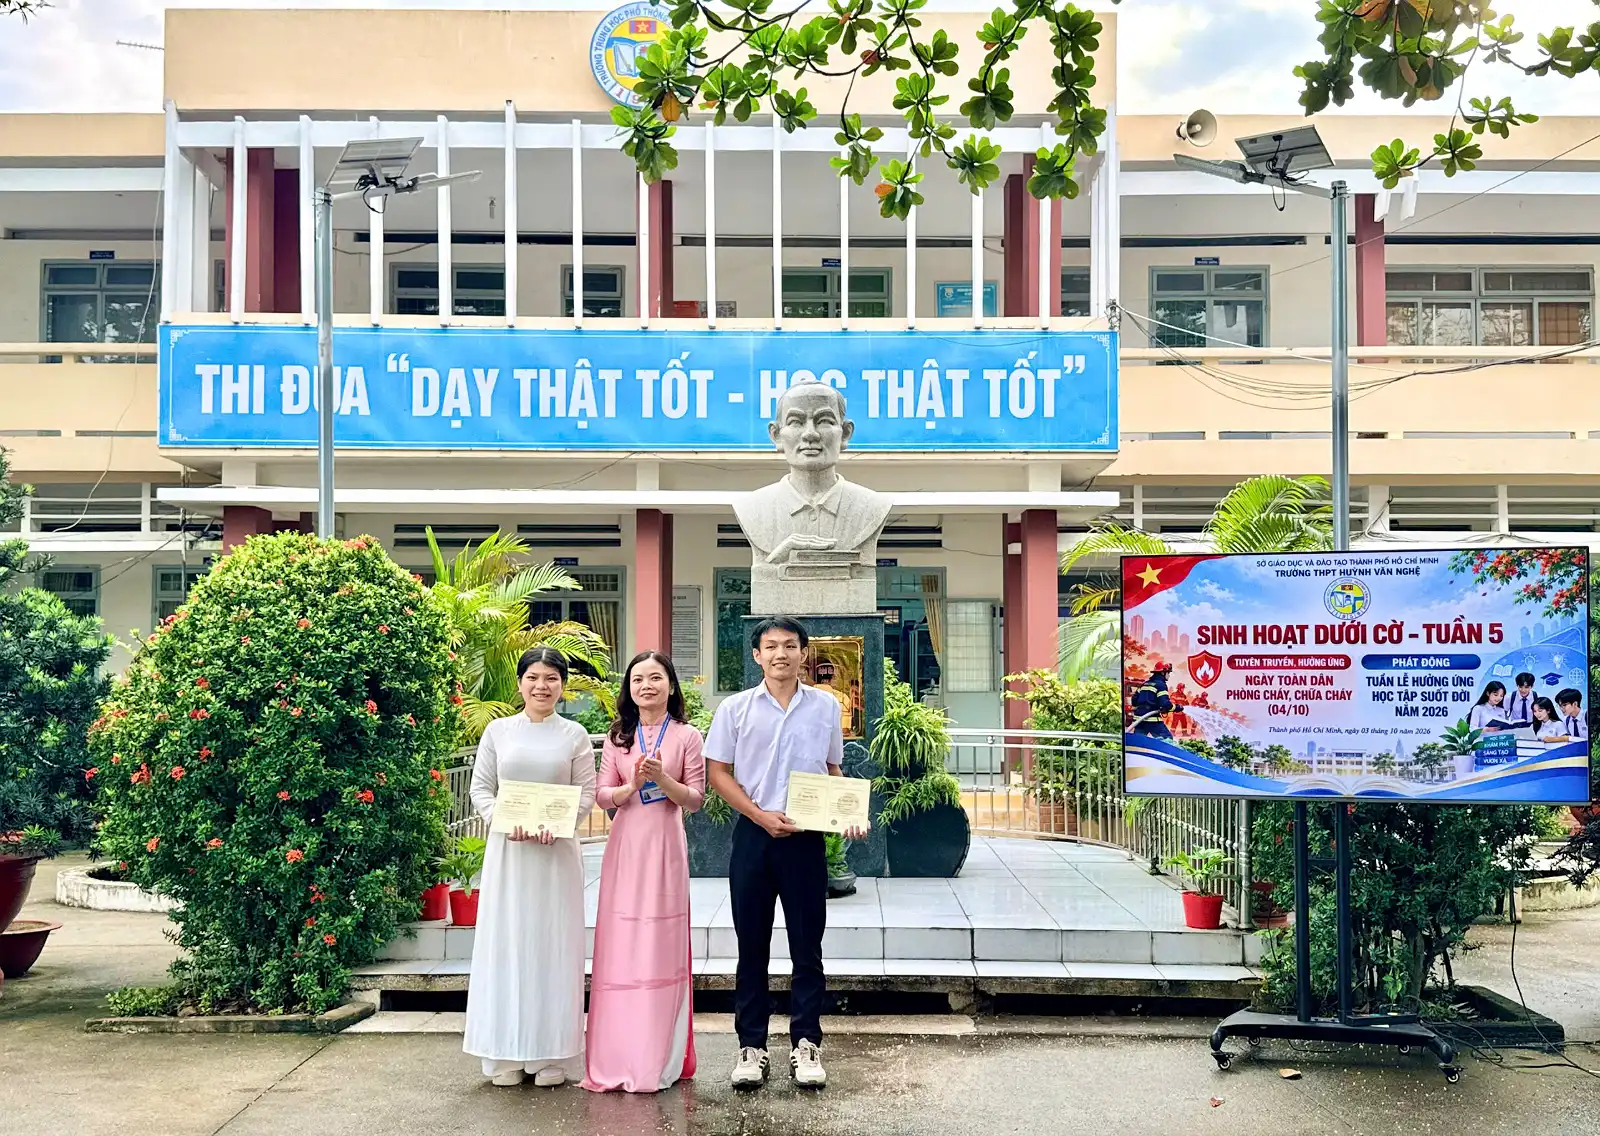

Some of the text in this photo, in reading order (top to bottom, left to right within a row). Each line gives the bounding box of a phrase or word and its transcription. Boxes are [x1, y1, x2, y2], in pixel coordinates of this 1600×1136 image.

[195, 363, 265, 414] THI
[386, 353, 500, 428] “DẠY
[513, 358, 622, 429] THẬT
[635, 351, 714, 419] TỐT
[861, 358, 969, 429] THẬT
[982, 351, 1086, 419] TỐT”
[1268, 559, 1286, 567] GIÁO
[1316, 557, 1331, 566] ĐÀO
[1374, 556, 1389, 565] PHỐ
[1275, 568, 1311, 577] TRƯỜNG
[1340, 567, 1371, 576] HUỲNH
[1374, 566, 1393, 576] VĂN
[1396, 566, 1420, 576] NGHỆ
[1197, 624, 1247, 645] SINH
[1252, 624, 1308, 649] HOẠT
[1314, 619, 1366, 644] DƯỚI
[1373, 619, 1404, 644] CỜ
[1422, 615, 1482, 644] TUẦN
[1488, 623, 1503, 644] 5
[1235, 657, 1260, 667] TUYÊN
[1328, 657, 1345, 667] ỨNG
[1392, 656, 1450, 668] PHÁT ĐỘNG
[1245, 673, 1334, 686] NGÀY TOÀN DÂN
[1397, 672, 1409, 686] LỄ
[1412, 673, 1449, 687] HƯỞNG
[1452, 674, 1474, 687] ỨNG
[1226, 687, 1352, 702] PHÒNG CHÁY, CHỮA CHÁY
[1372, 688, 1470, 704] HỌC TẬP SUỐT ĐỜI
[1268, 704, 1309, 716] (04/10)
[1395, 703, 1448, 717] NĂM 2026
